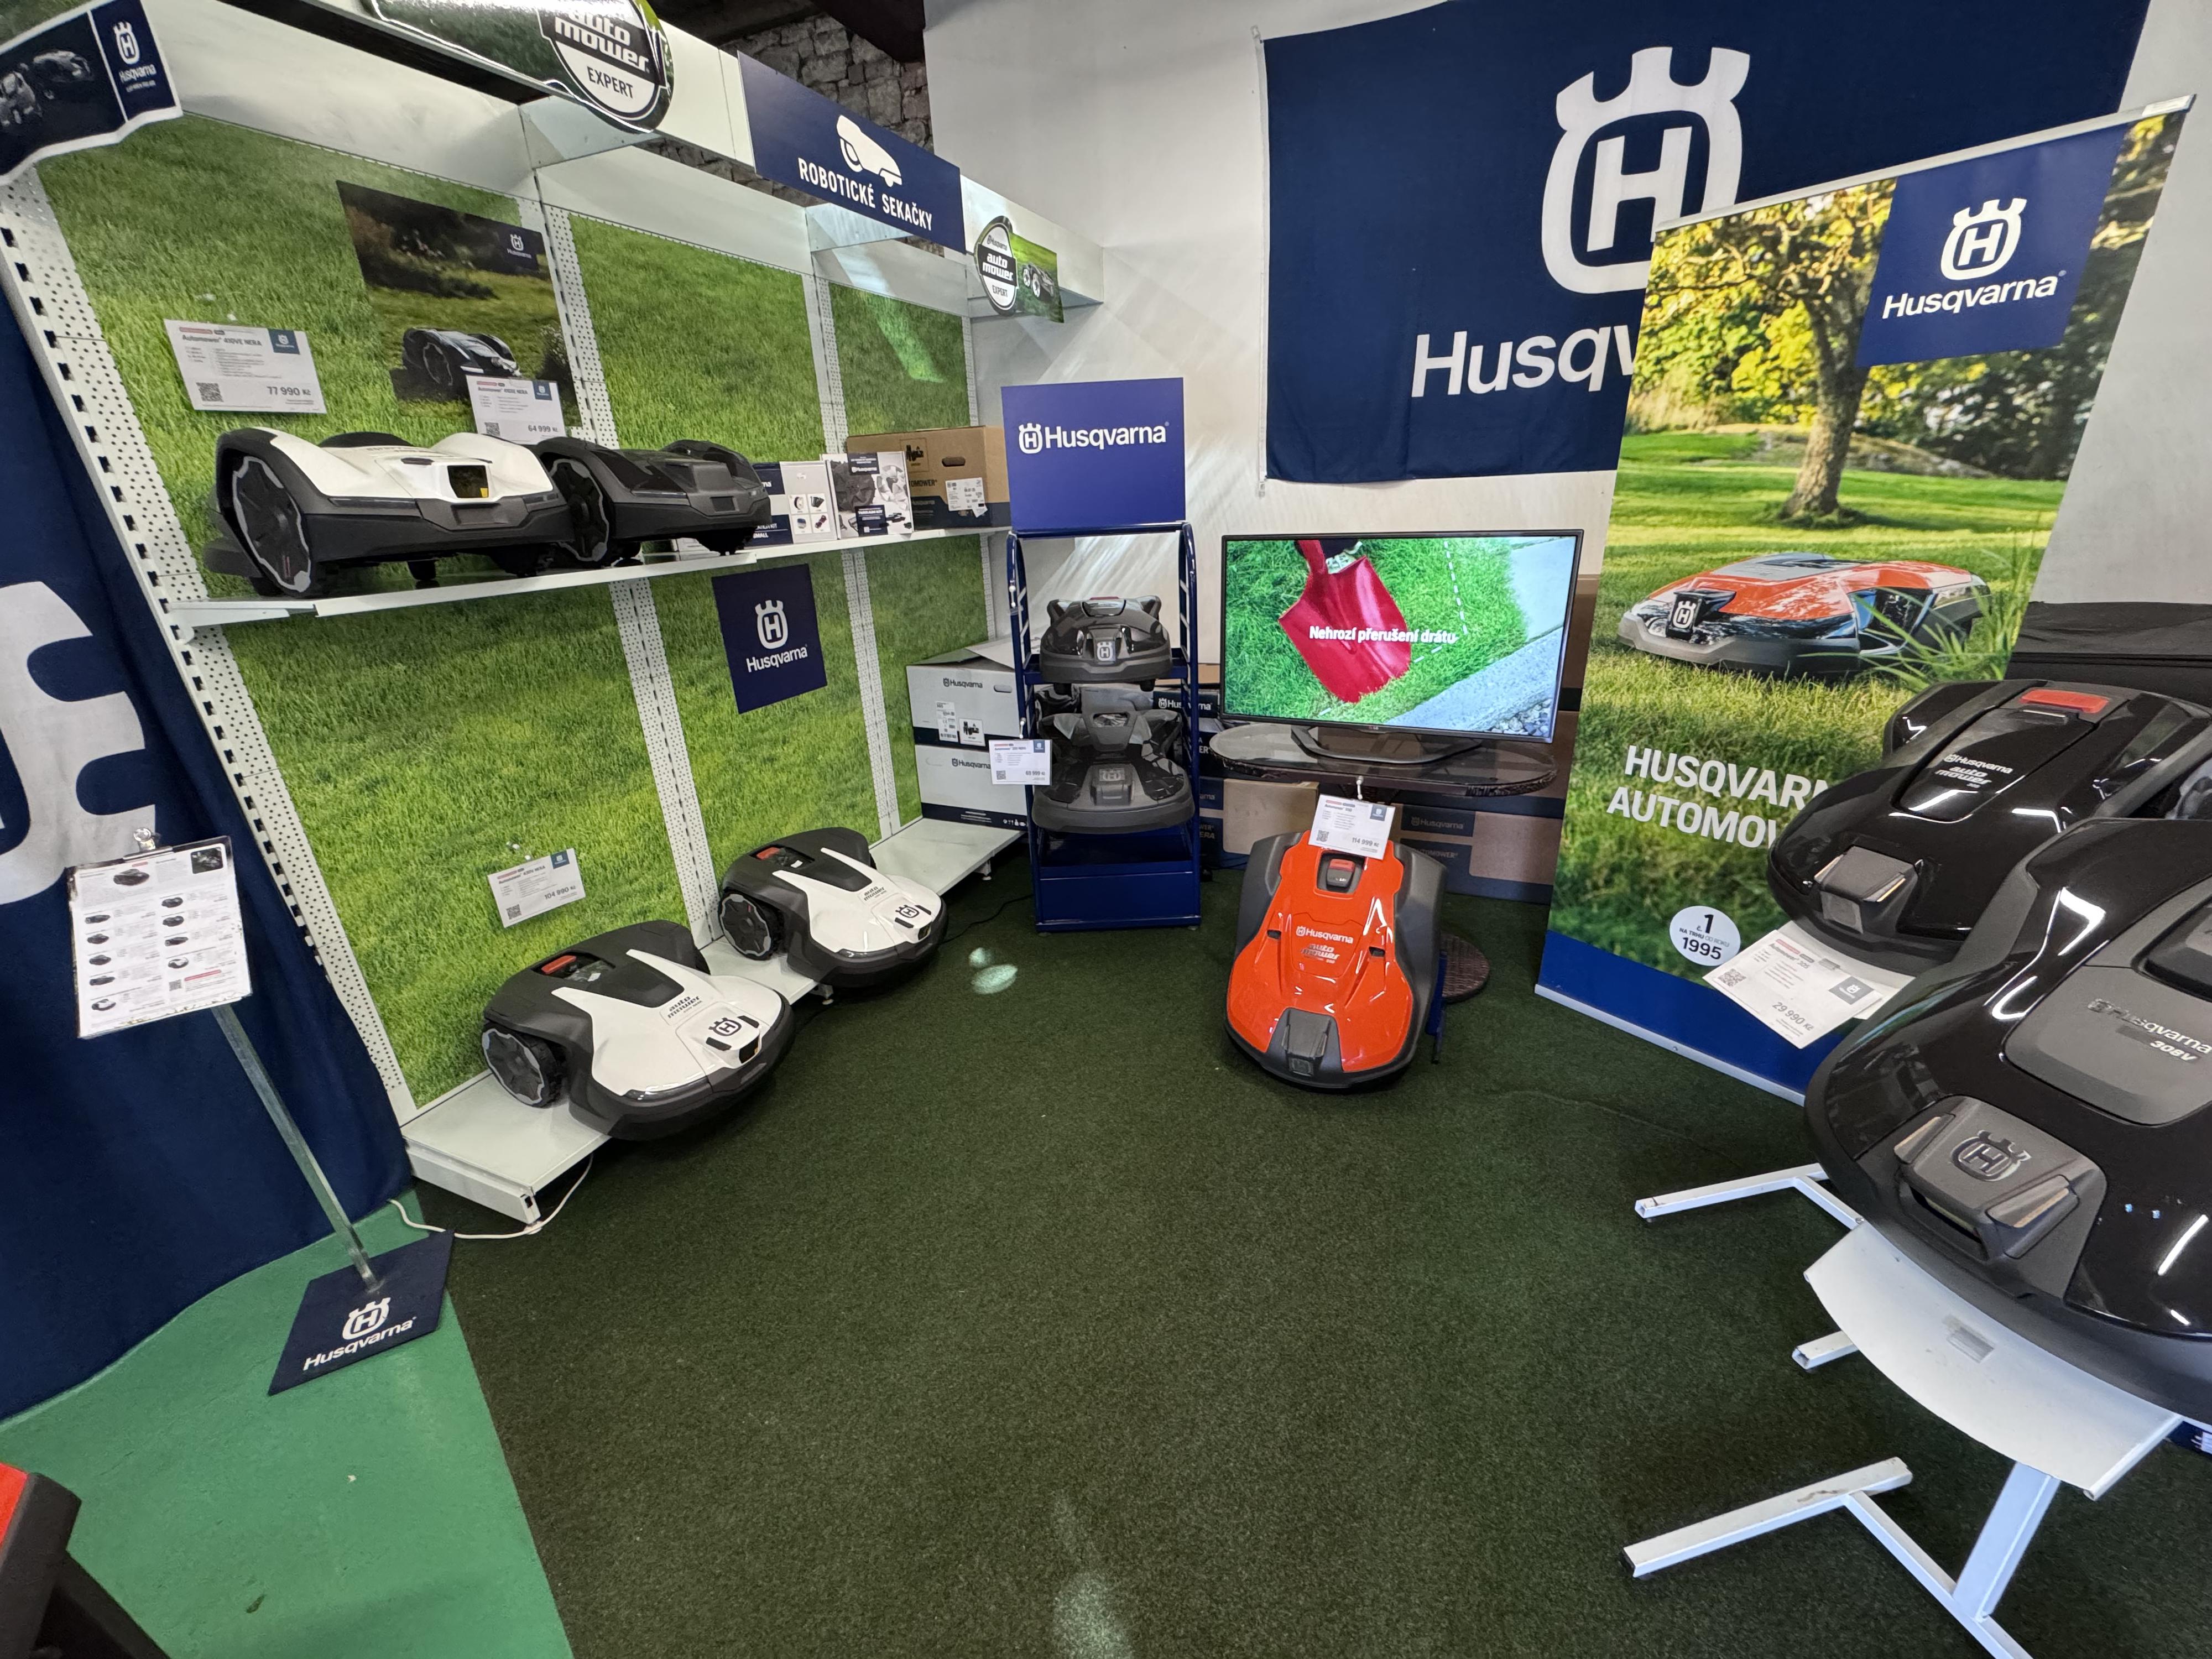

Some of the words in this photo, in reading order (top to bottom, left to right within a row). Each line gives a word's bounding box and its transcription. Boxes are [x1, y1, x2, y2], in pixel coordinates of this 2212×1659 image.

[555, 17, 649, 72] mower
[587, 66, 633, 98] EXPERT
[798, 157, 876, 209] ROBOTICKÉ
[881, 194, 932, 231] SEKAČKY
[987, 253, 1008, 269] auto
[982, 262, 1014, 281] mower
[992, 285, 1008, 298] EXPERT
[1882, 275, 2059, 320] Husqvarna
[267, 386, 279, 396] 77
[281, 387, 300, 396] 990
[1045, 425, 1166, 450] Husqvarna
[1309, 625, 1357, 641] Nehrozí
[1357, 627, 1420, 644] přerušení
[1420, 629, 1456, 644] drátu
[746, 646, 808, 673] Husqvarna
[950, 679, 983, 688] Husqvarna
[958, 760, 991, 769] Husqvarna
[1949, 766, 1988, 778] auto
[1955, 755, 2013, 774] Husqvarna
[1934, 769, 1992, 785] mower
[1361, 838, 1373, 847] 999
[544, 891, 556, 900] 104
[556, 886, 569, 895] 990
[1704, 914, 1714, 934] 1
[1305, 928, 1354, 944] Husqvarna
[1688, 930, 1705, 940] TRHU
[1308, 943, 1334, 953] auto
[1682, 937, 1723, 960] 1995
[667, 995, 700, 1019] mower
[669, 996, 691, 1012] auto
[1772, 1001, 1787, 1013] 29
[1784, 1009, 1806, 1025] 990
[2150, 1040, 2198, 1061] 308V
[303, 1318, 414, 1371] Husqvarna
